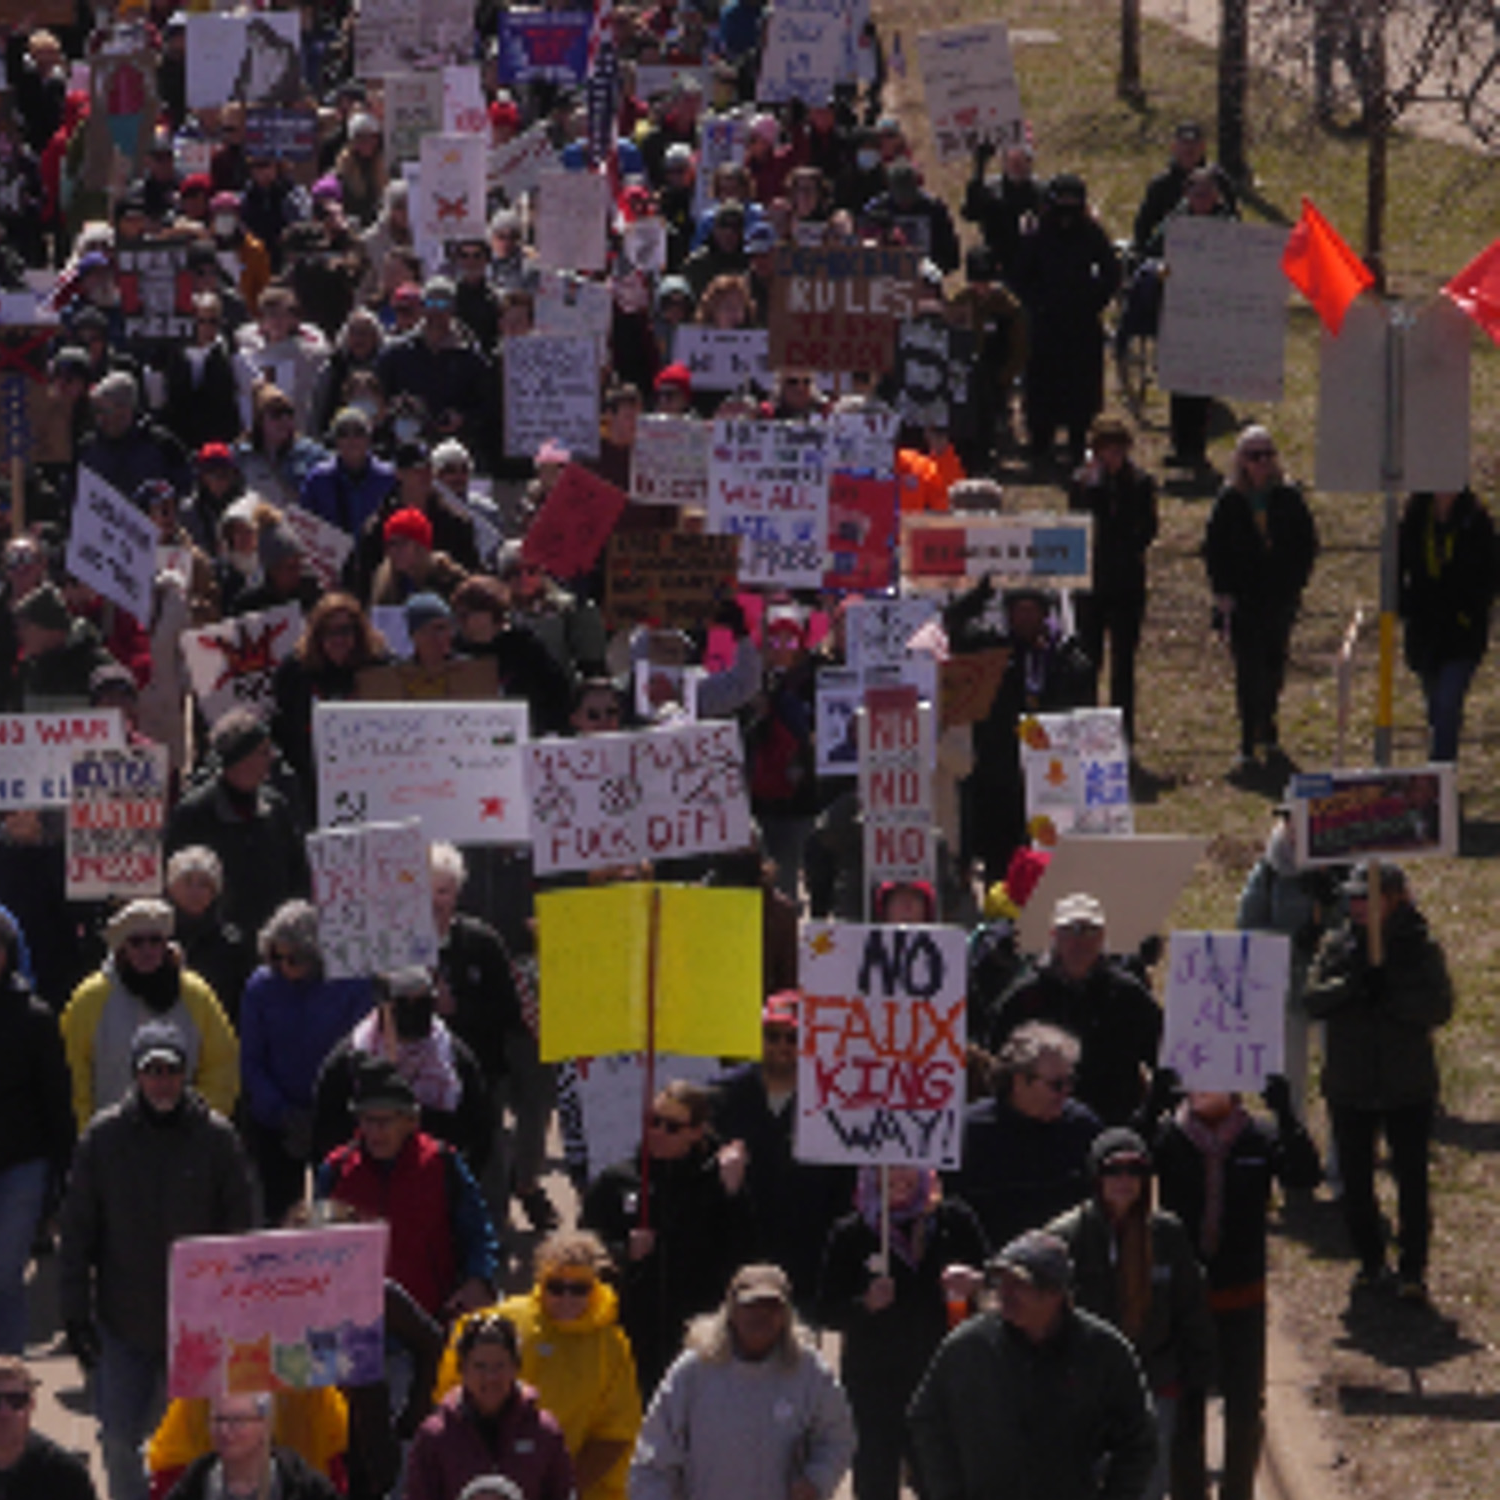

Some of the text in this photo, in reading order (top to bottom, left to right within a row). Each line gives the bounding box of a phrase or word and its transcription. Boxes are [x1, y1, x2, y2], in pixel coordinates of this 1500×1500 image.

[788, 274, 913, 320] RULES
[868, 704, 919, 751] NO
[869, 768, 920, 806] NO
[551, 820, 637, 865] FUCK
[875, 826, 925, 866] NO
[857, 928, 943, 998] NO
[802, 993, 967, 1068] FAUX
[1235, 1043, 1266, 1075] IT
[814, 1055, 954, 1110] KING
[825, 1108, 955, 1165] WAY!
